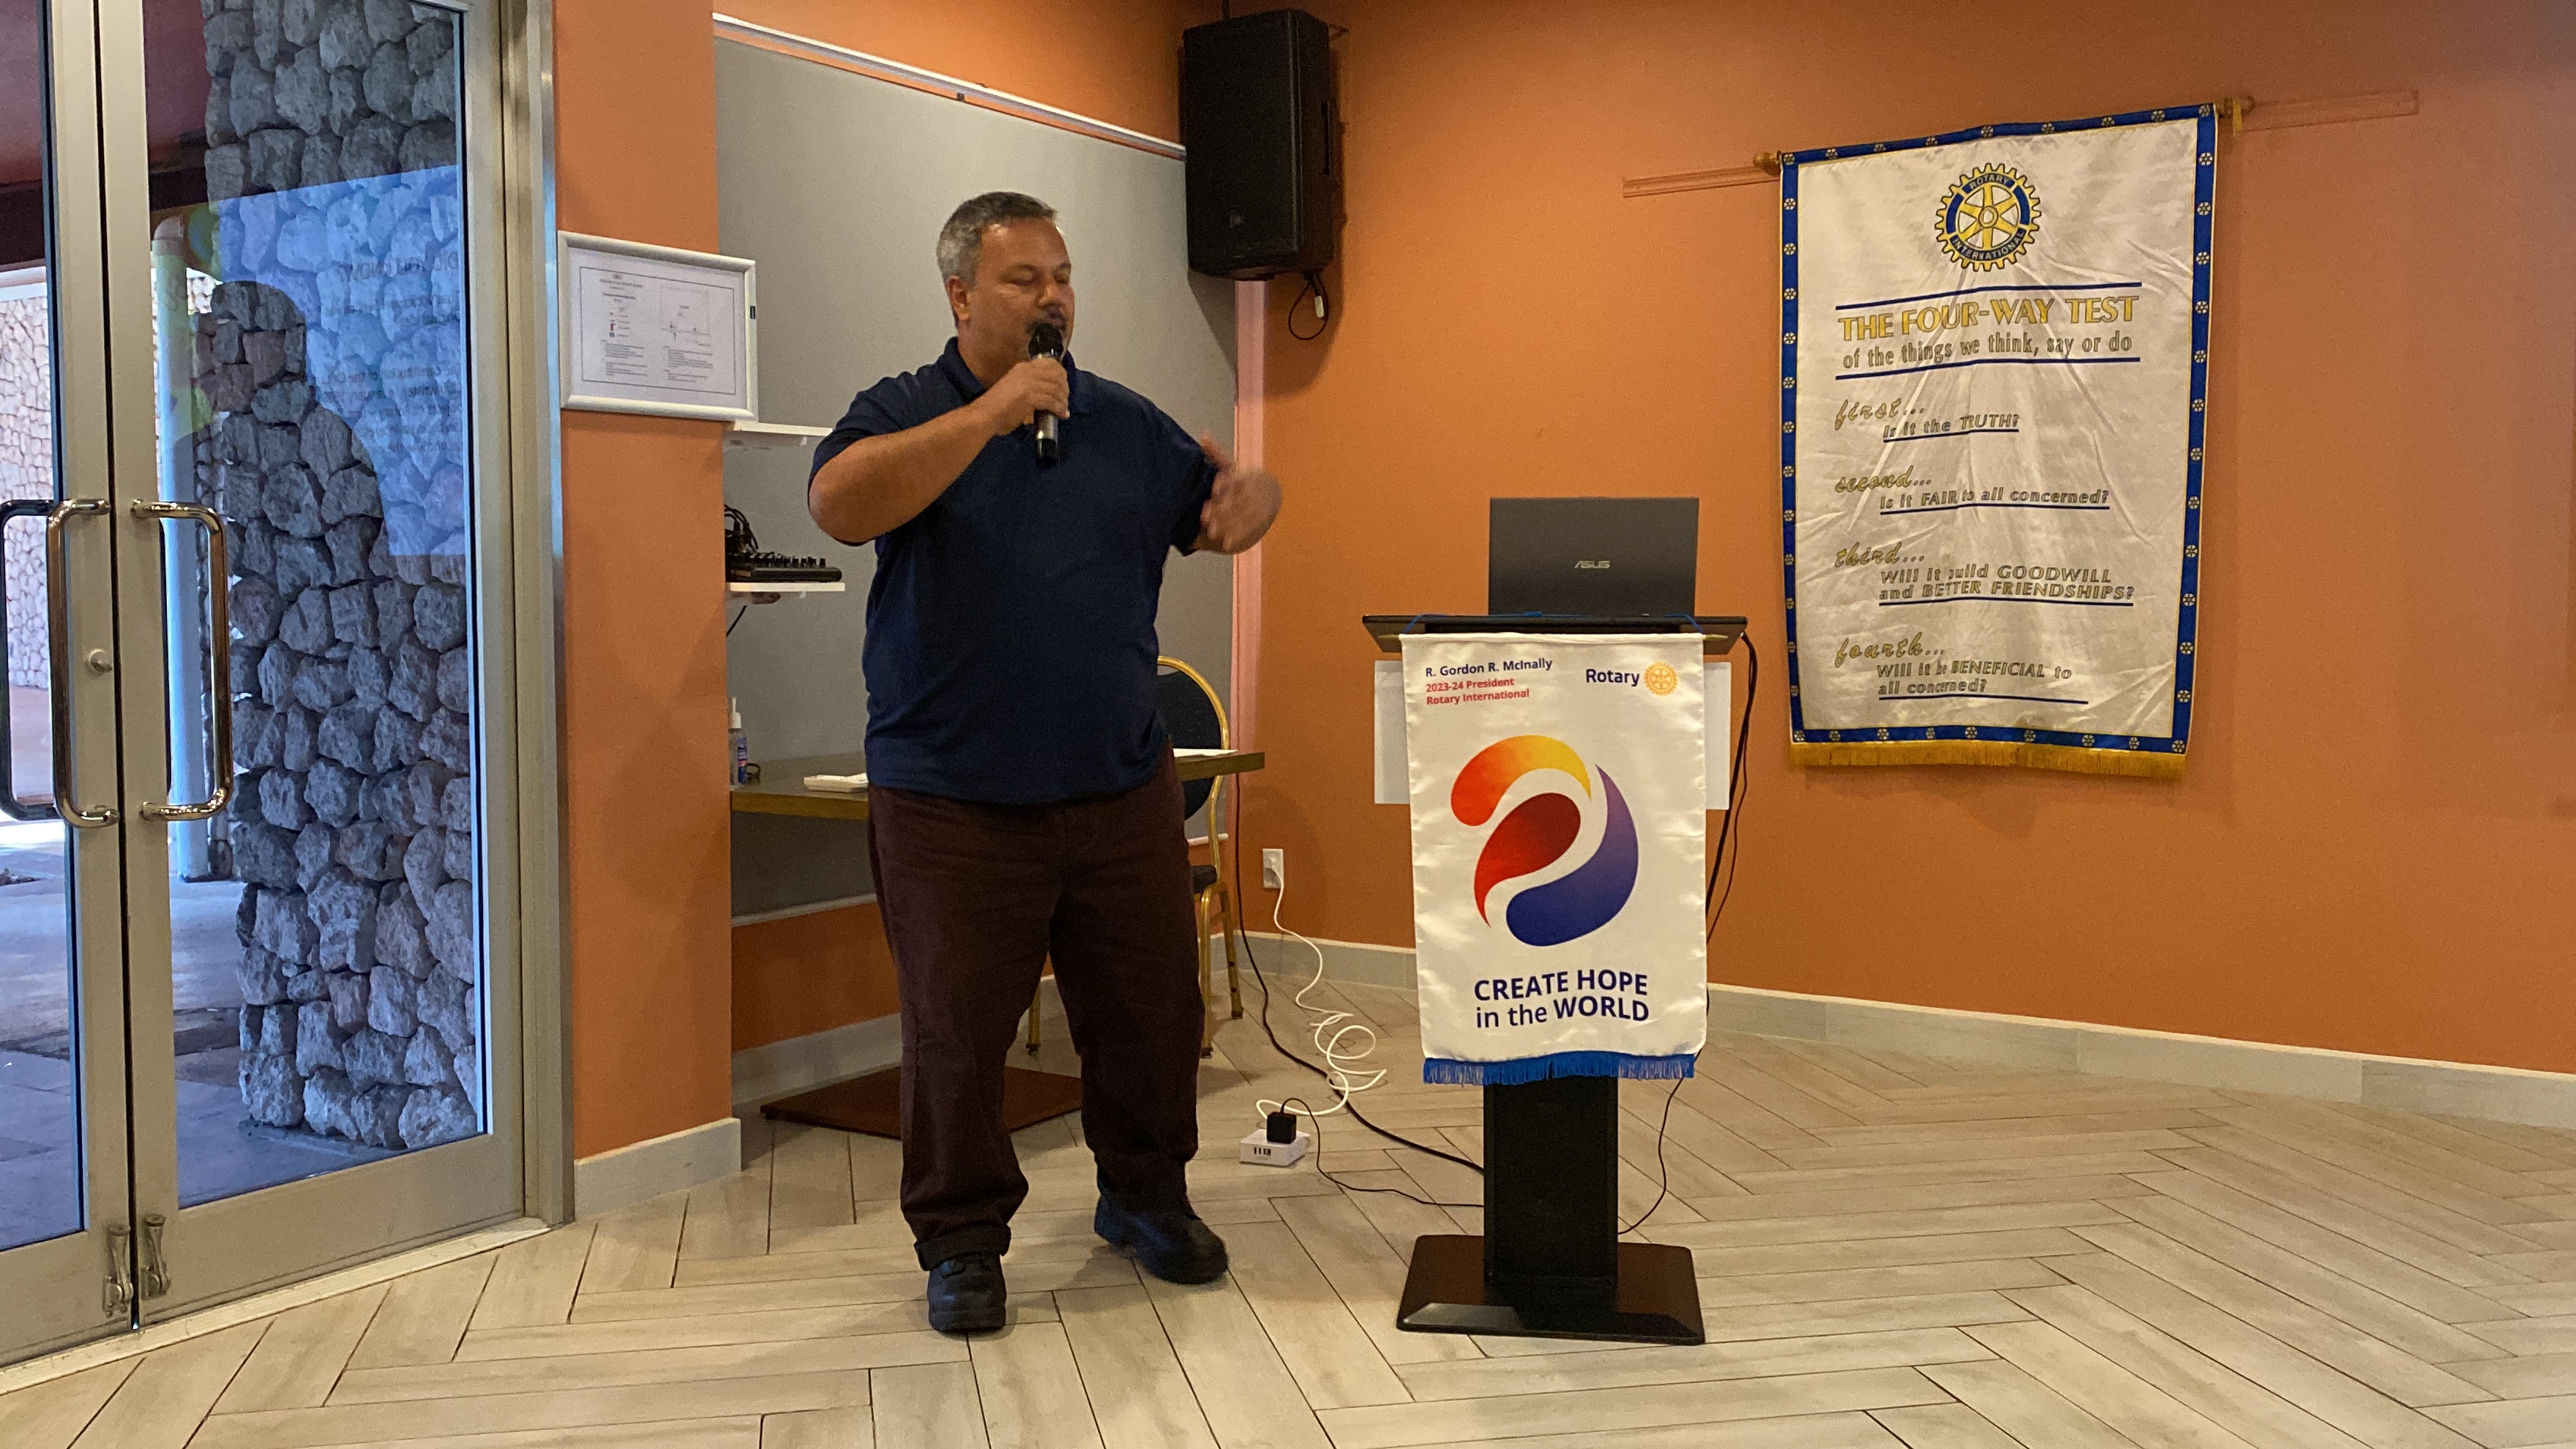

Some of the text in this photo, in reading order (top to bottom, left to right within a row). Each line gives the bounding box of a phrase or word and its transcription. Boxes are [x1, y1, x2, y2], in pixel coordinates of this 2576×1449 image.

[1970, 173, 2010, 190] ROTARY
[1952, 231, 2024, 261] INTERNATIONAL
[1838, 295, 2139, 342] THE FOUR-WAY TEST
[1843, 331, 2133, 369] of the things we think, say or do
[1883, 413, 2020, 438] Is it the TRUTH?
[1880, 487, 2110, 509] Is it FAIR to all concerned?
[1574, 561, 1610, 569] ASUS
[1880, 568, 1919, 584] Will
[1927, 567, 1941, 581] it
[1996, 565, 2112, 583] GOODWILL
[1879, 580, 2135, 600] and BETTER FRIENDSHIPS?
[1426, 658, 1553, 677] R. Gordon R. McInally
[1585, 667, 1640, 686] Rotary
[1876, 662, 1912, 678] Will
[1918, 662, 1931, 675] it
[1950, 660, 2045, 678] BENEFICIAL
[2054, 666, 2072, 679] to
[1426, 678, 1515, 692] 2023-24 President
[1878, 681, 1901, 694] all
[1426, 689, 1530, 705] Rotary International
[1474, 969, 1647, 1001] CREATE HOPE
[1476, 995, 1649, 1028] in the WORLD
